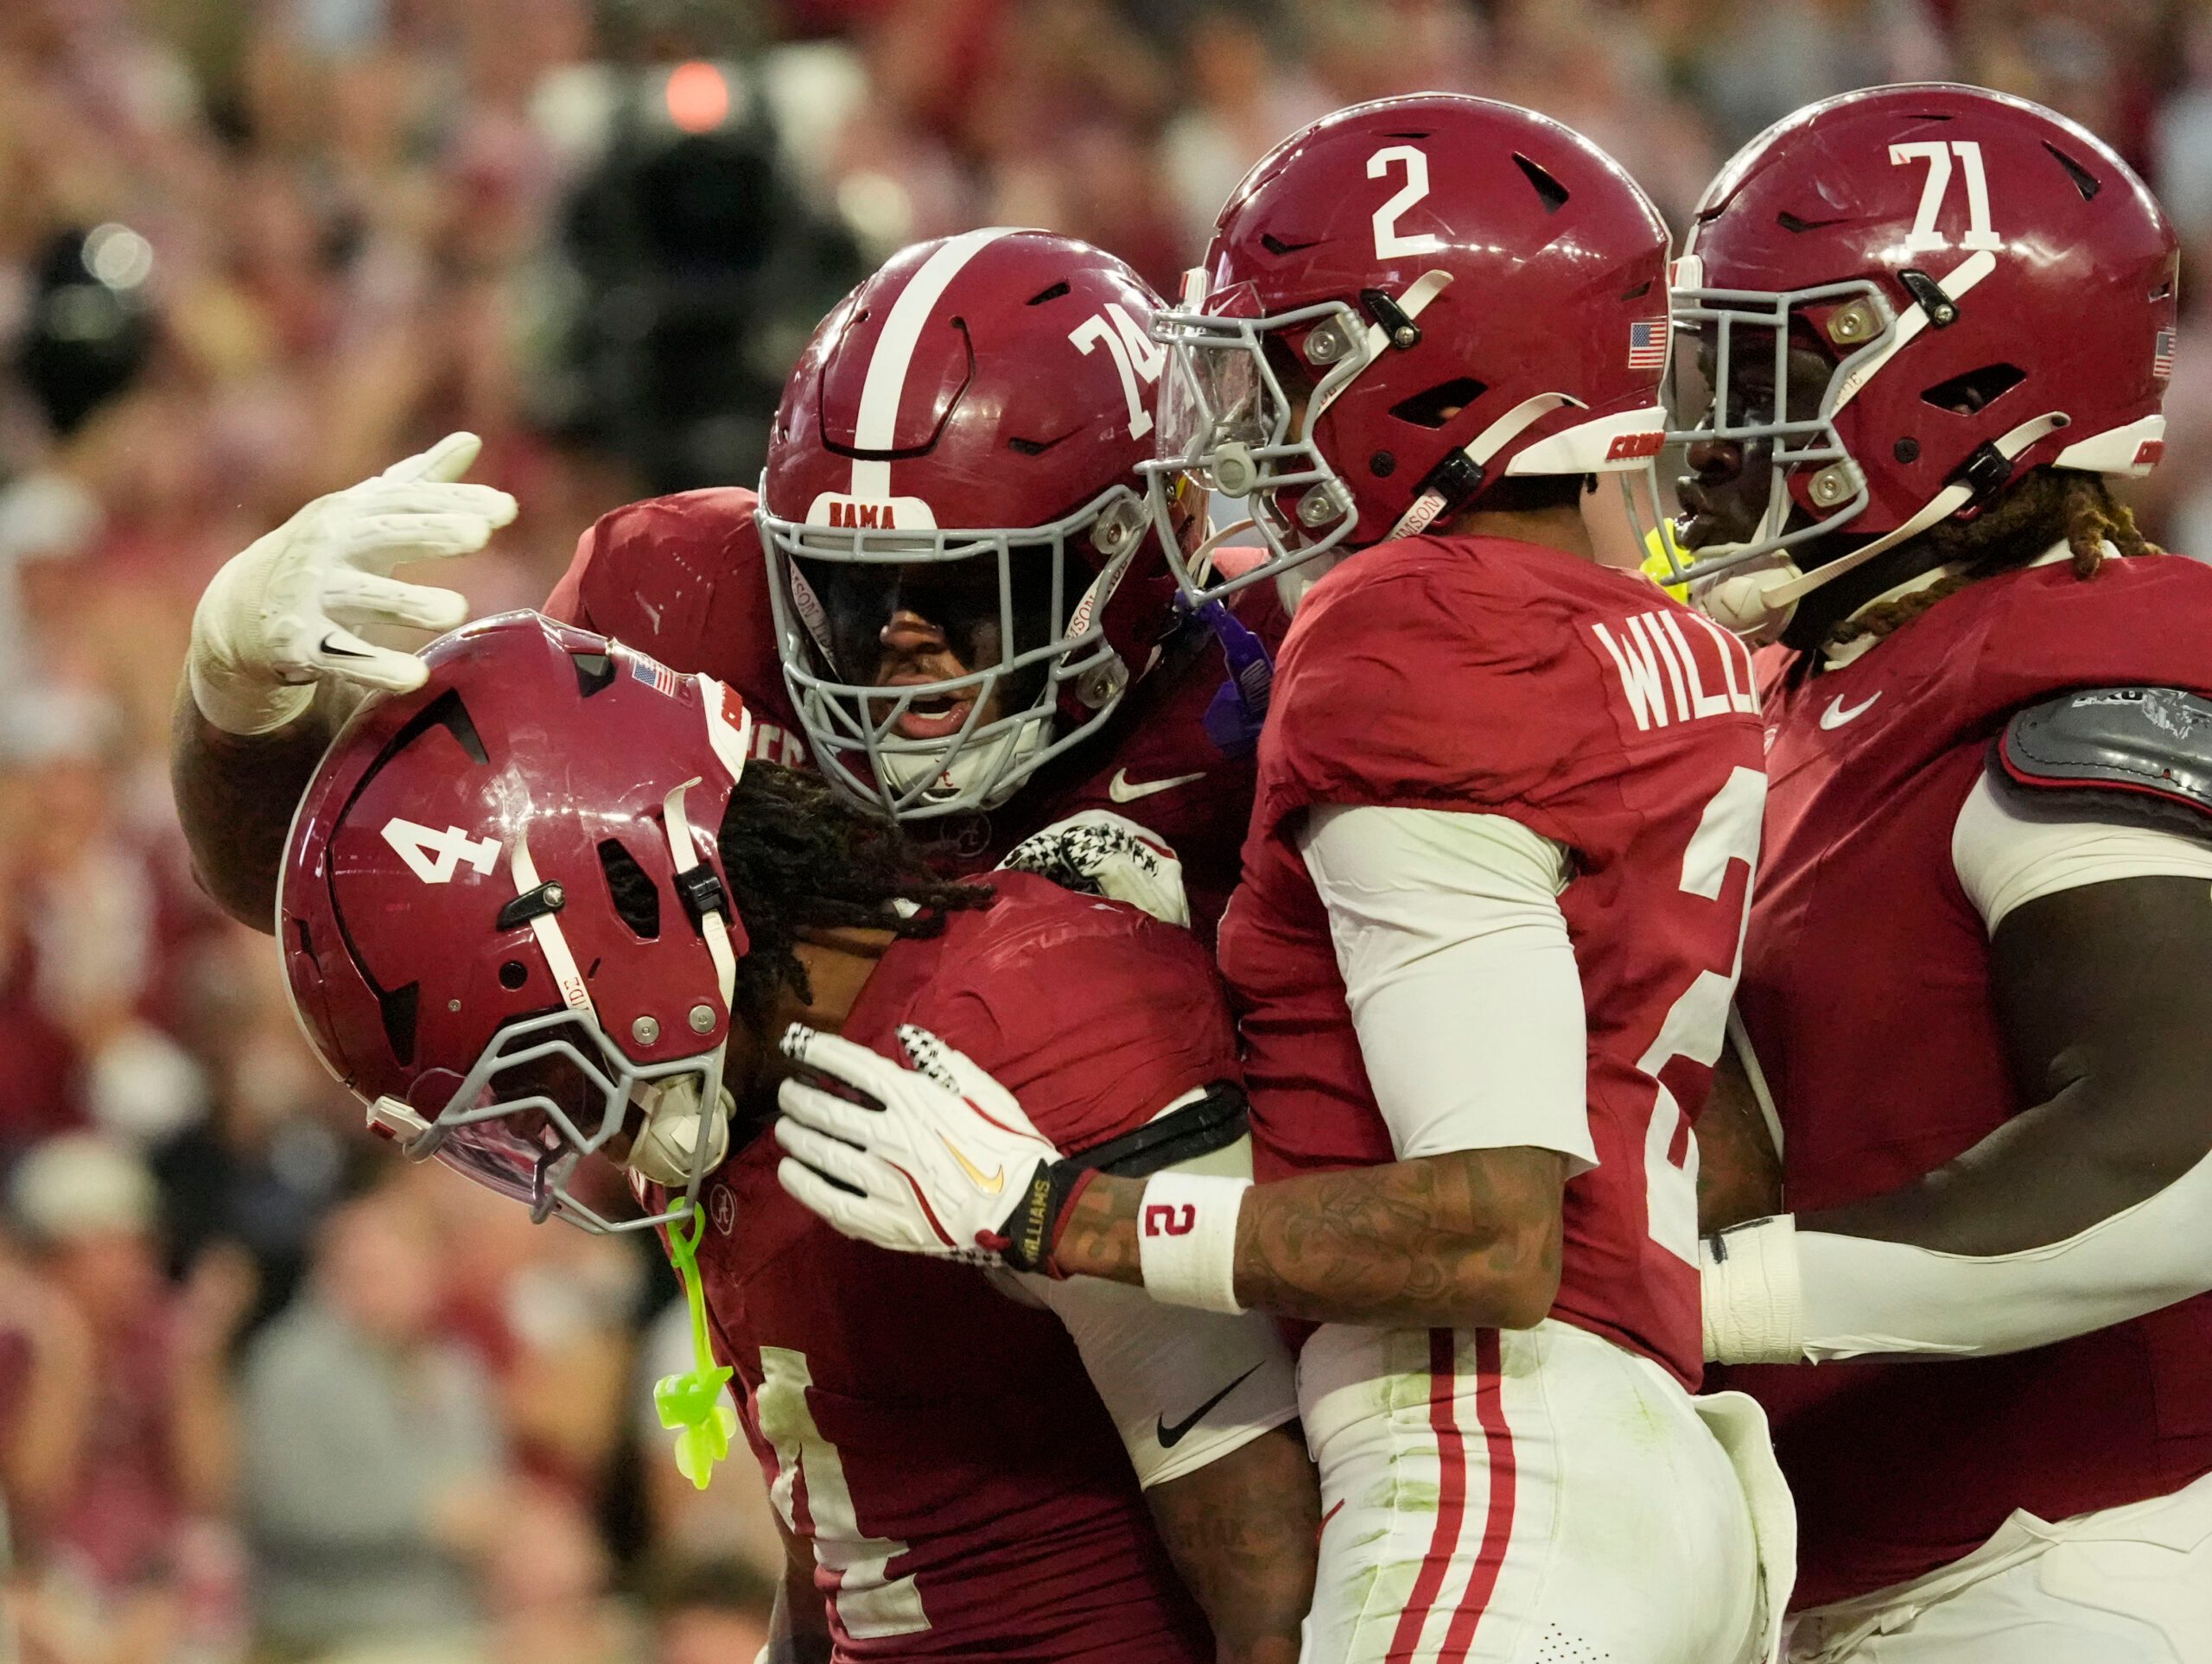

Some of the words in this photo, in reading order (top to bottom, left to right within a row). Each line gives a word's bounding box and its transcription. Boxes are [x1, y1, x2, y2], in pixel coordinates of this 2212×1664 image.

[1366, 144, 1438, 260] 2
[1888, 140, 2001, 252] 71
[1067, 302, 1166, 441] 74
[830, 502, 895, 530] BAMA
[380, 817, 503, 884] 4
[1022, 1179, 1050, 1263] WILLIAMS
[1146, 1204, 1196, 1237] 2
